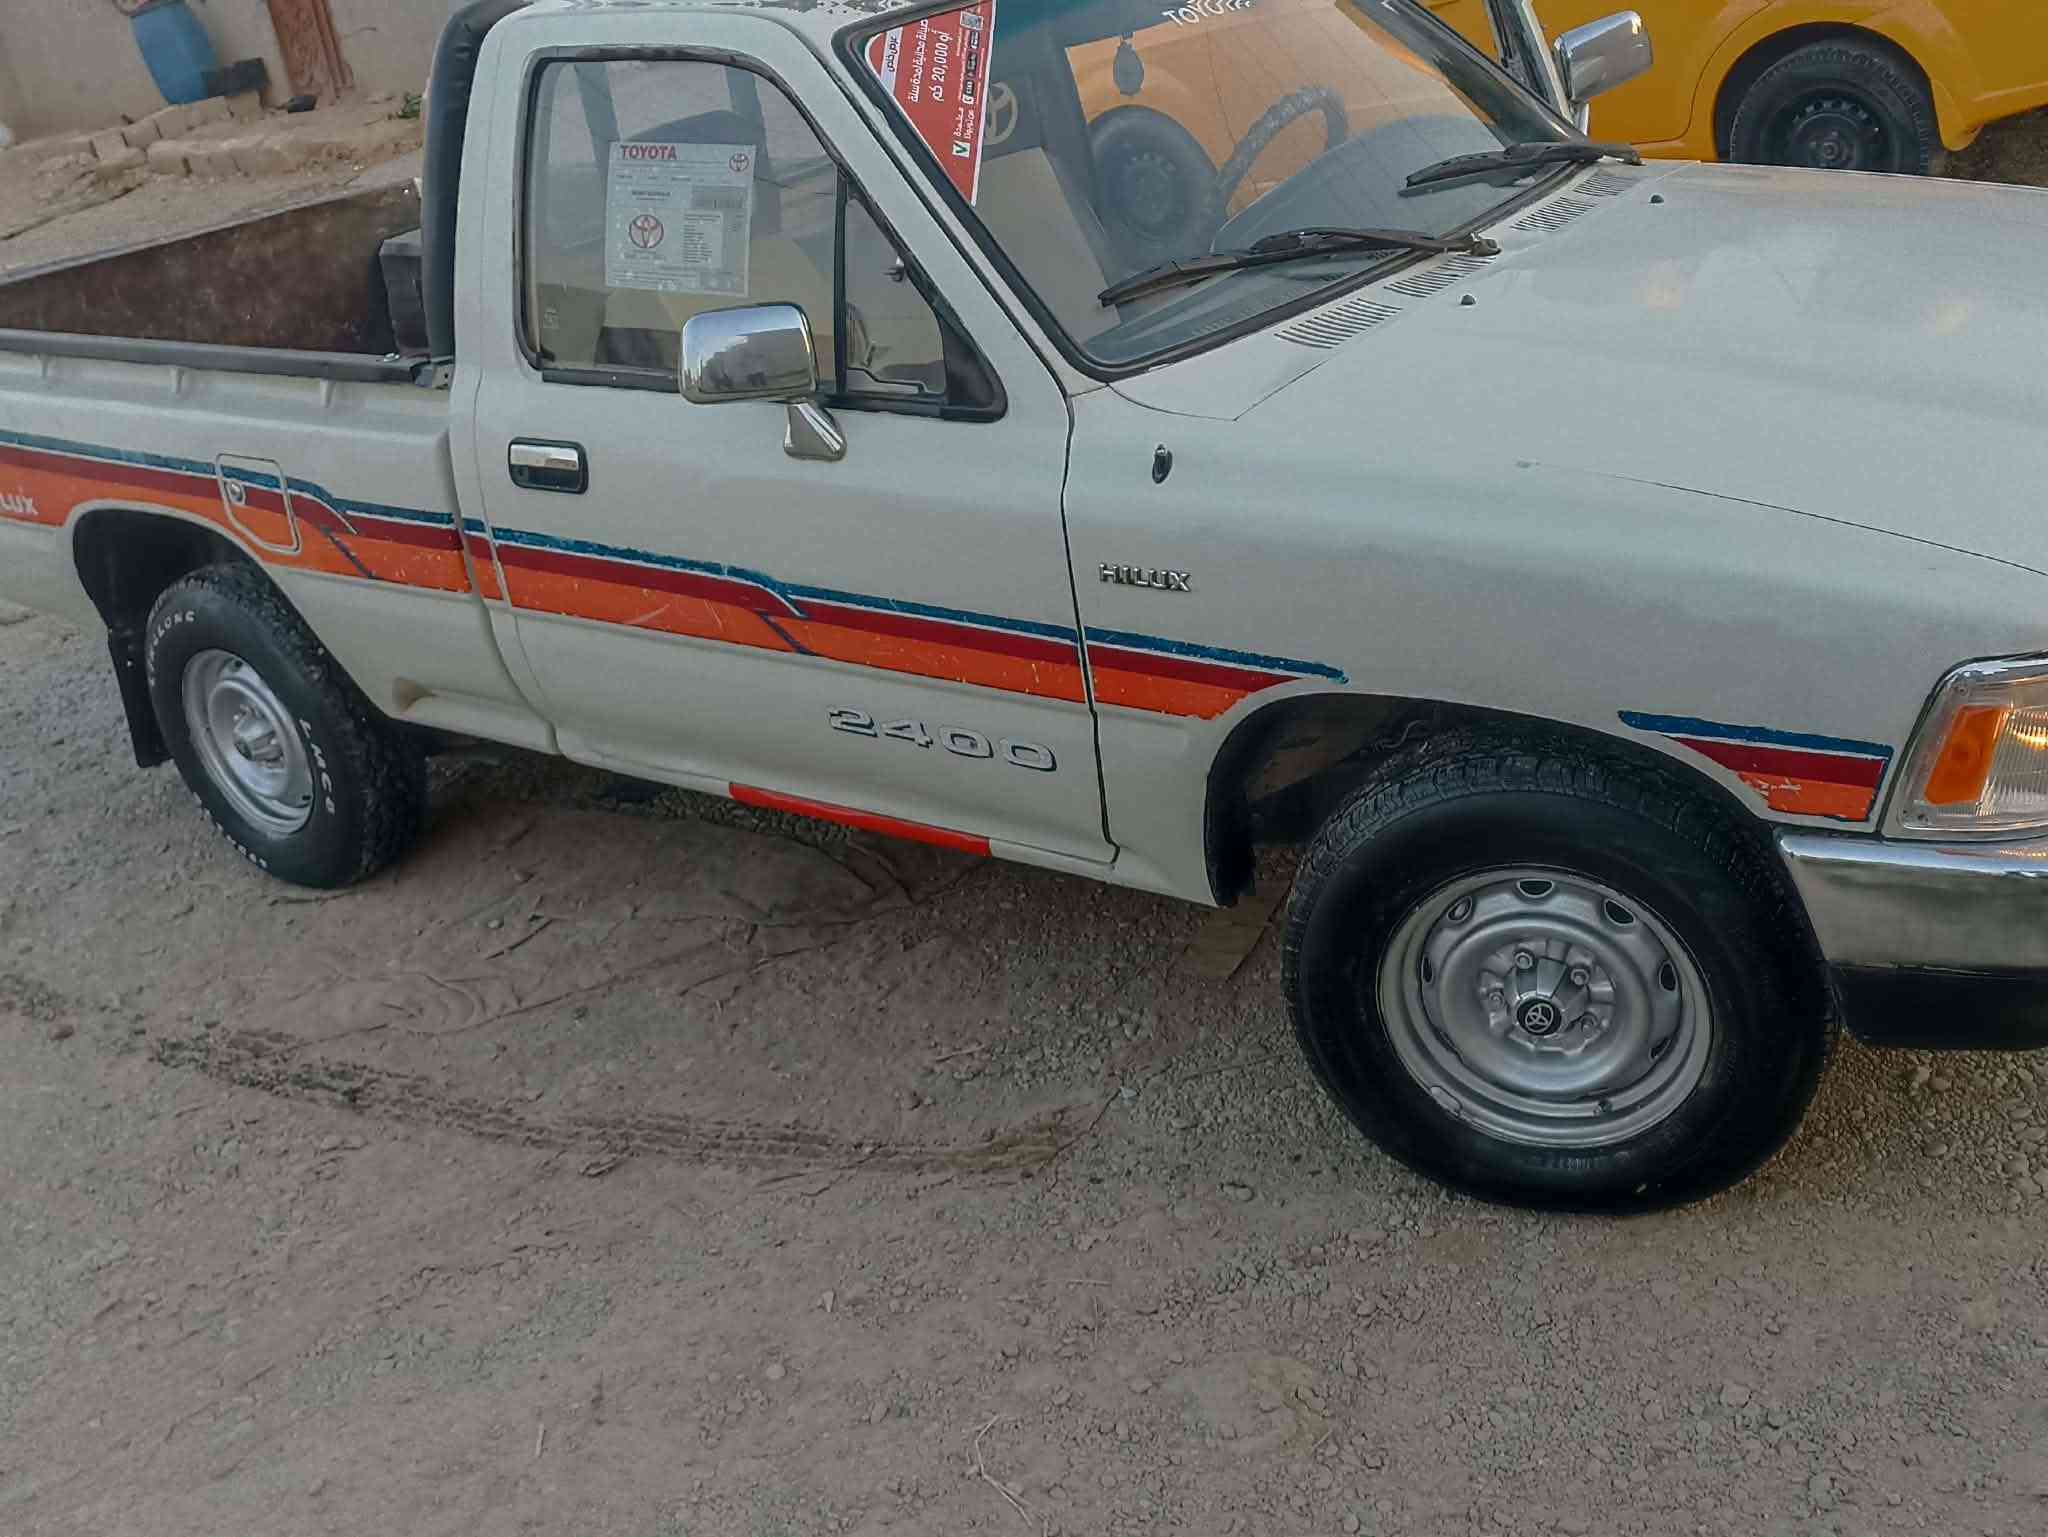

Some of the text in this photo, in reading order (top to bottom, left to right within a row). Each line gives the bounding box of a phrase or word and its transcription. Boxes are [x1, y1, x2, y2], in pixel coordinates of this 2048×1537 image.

[888, 35, 899, 54] عرض
[931, 42, 949, 82] 20,000
[929, 85, 945, 102] كم
[620, 145, 677, 160] TOYOTA
[1098, 562, 1193, 593] HILUX
[826, 704, 1058, 772] 2400
